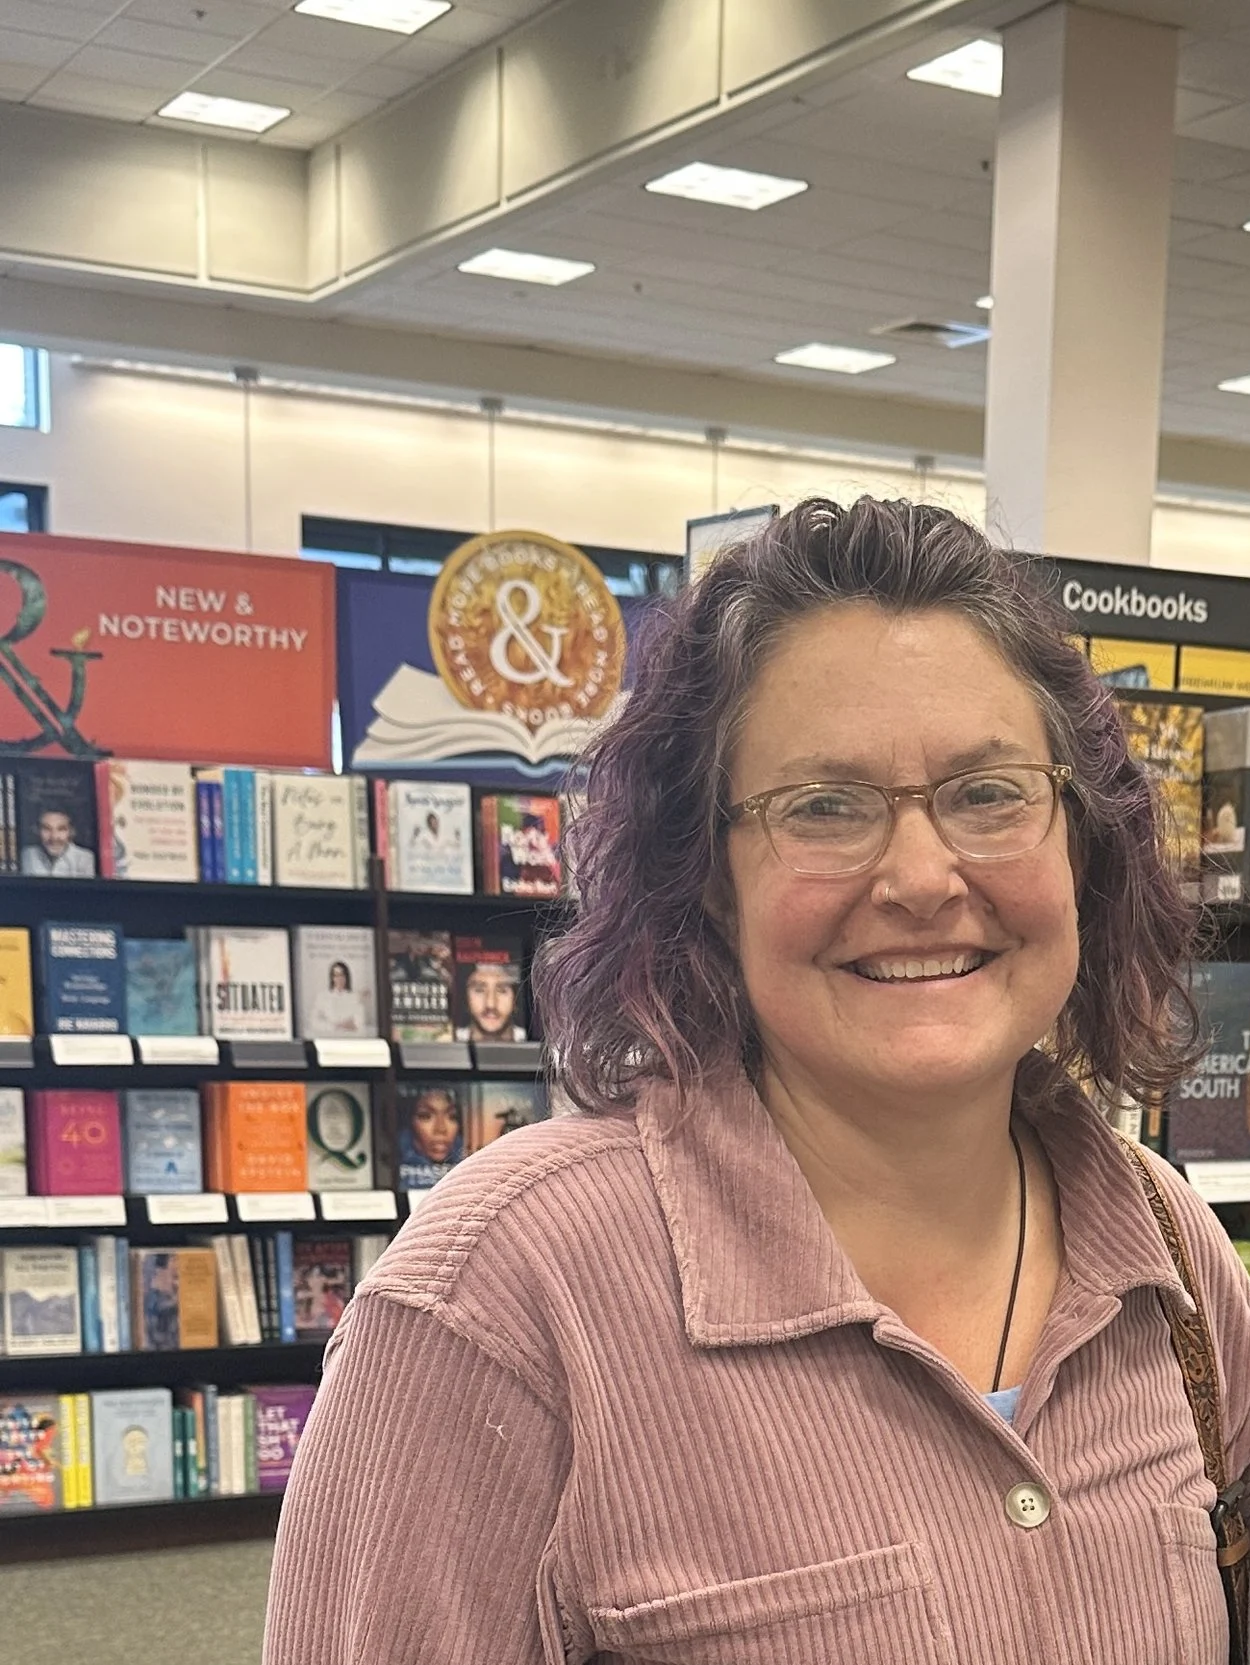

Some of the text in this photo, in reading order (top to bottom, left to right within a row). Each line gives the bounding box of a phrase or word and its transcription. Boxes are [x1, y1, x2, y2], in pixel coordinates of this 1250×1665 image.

[156, 585, 254, 615] NEW &
[1063, 580, 1208, 623] Cookbooks
[99, 613, 308, 651] NOTEWORTHY
[1179, 1078, 1241, 1099] SOUTH
[307, 1087, 367, 1169] Q
